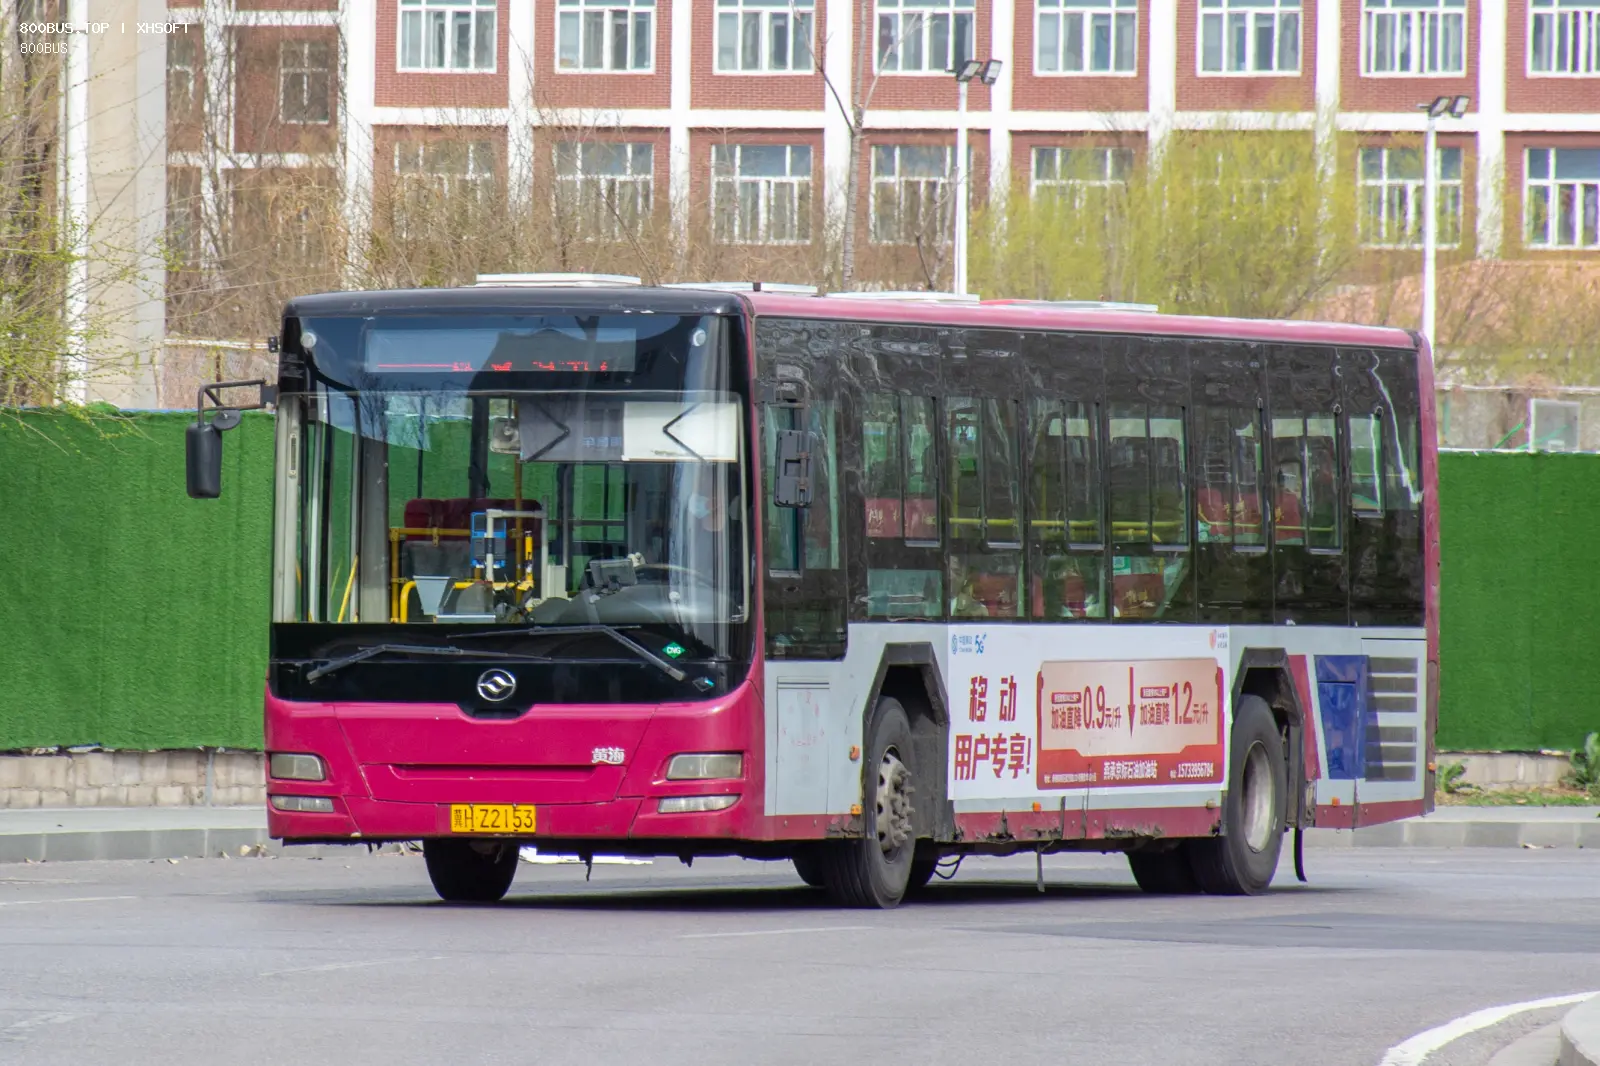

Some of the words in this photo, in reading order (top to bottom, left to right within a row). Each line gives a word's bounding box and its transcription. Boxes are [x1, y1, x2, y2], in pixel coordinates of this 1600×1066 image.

[592, 747, 625, 764] 黄海
[955, 732, 1032, 781] 用户专享!
